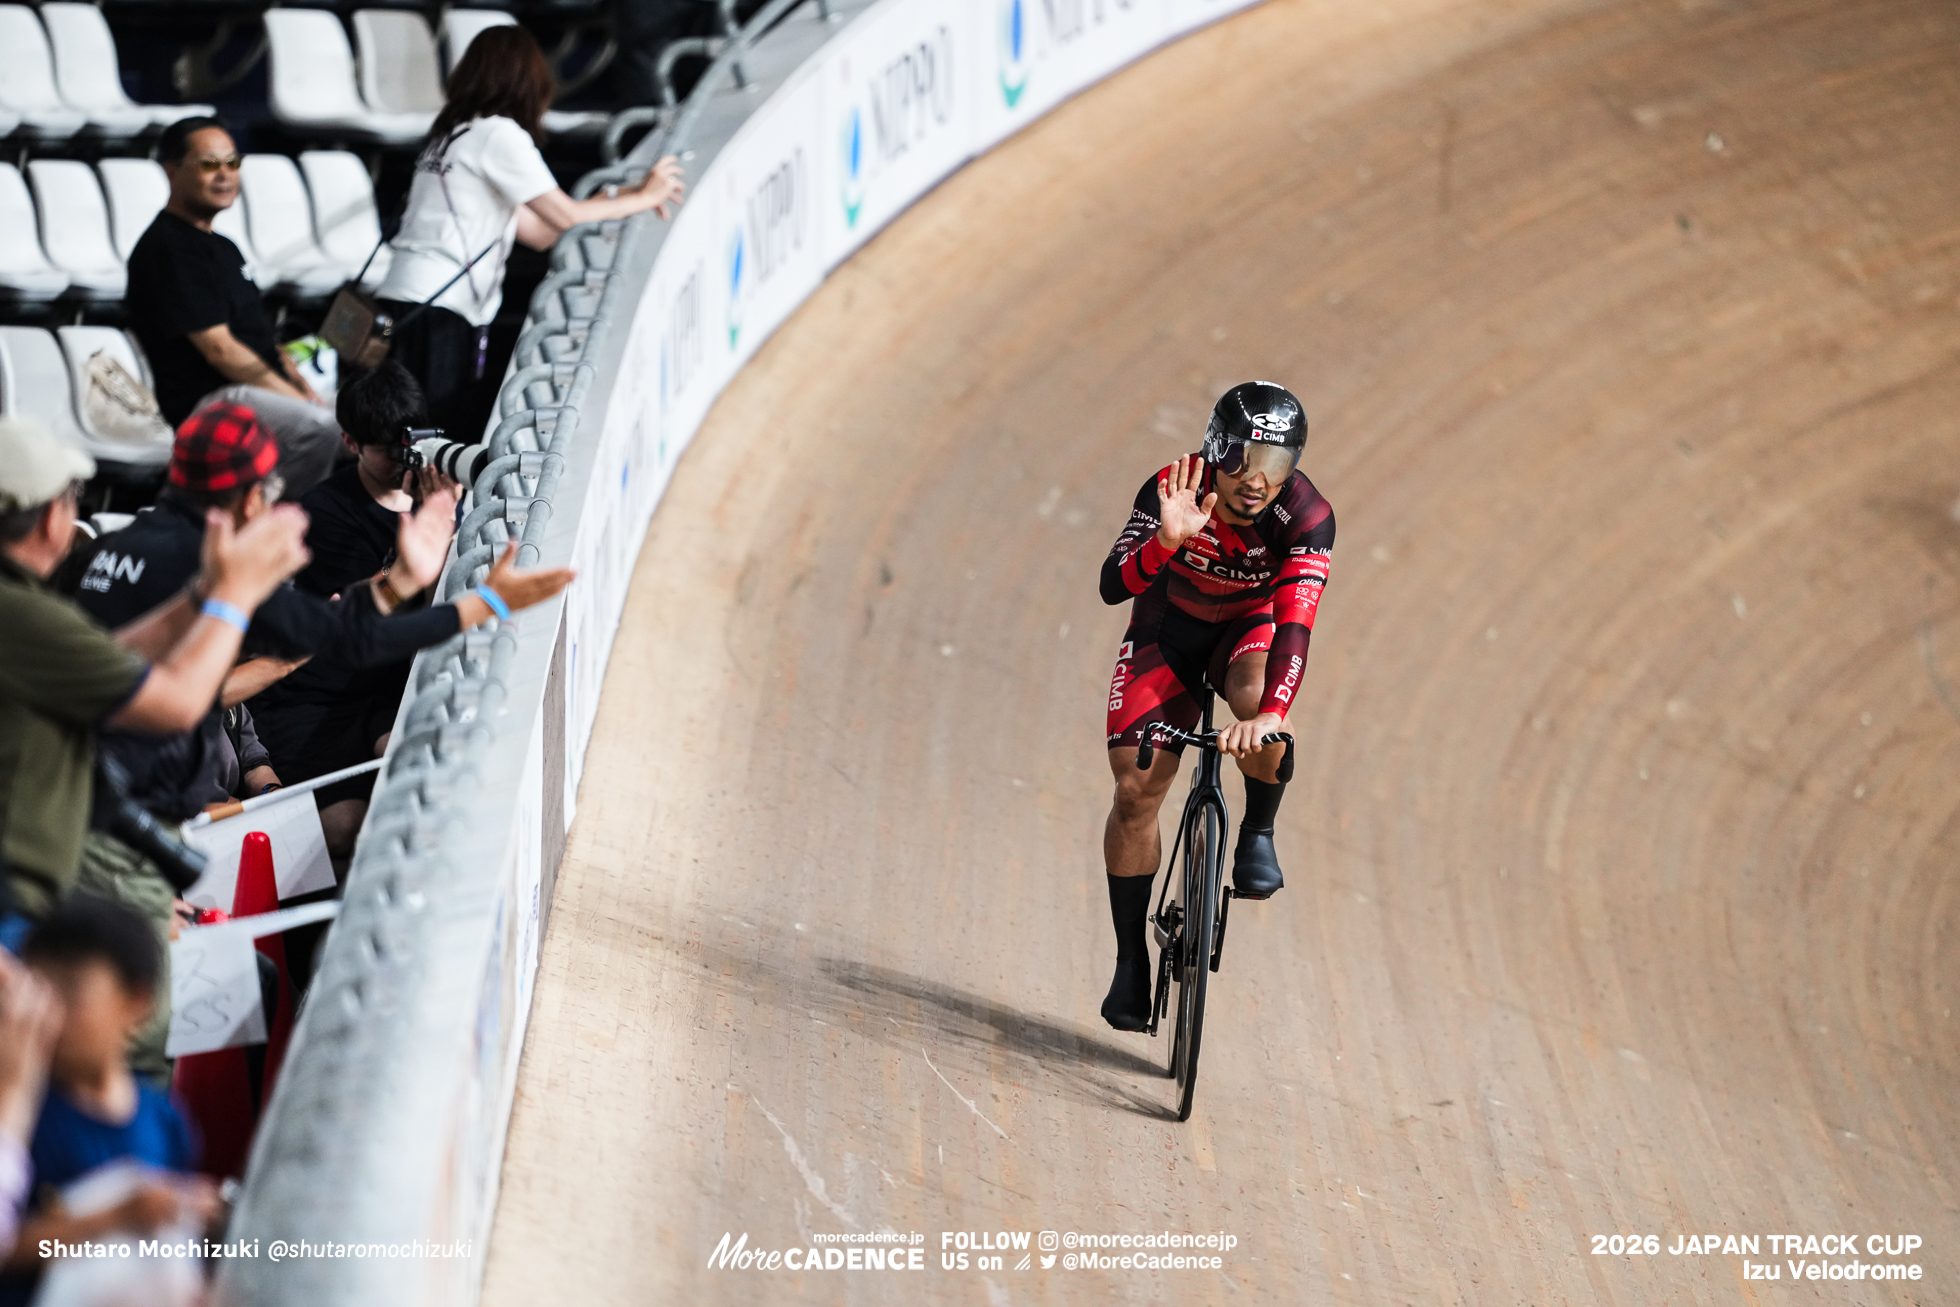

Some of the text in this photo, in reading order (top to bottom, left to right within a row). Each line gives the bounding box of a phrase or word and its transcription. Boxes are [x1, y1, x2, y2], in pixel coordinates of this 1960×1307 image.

[1263, 432, 1286, 443] CIMB
[1213, 565, 1271, 581] CIMB
[1284, 654, 1303, 687] CIMB
[1109, 663, 1127, 712] CIMB
[1135, 730, 1173, 744] TAM
